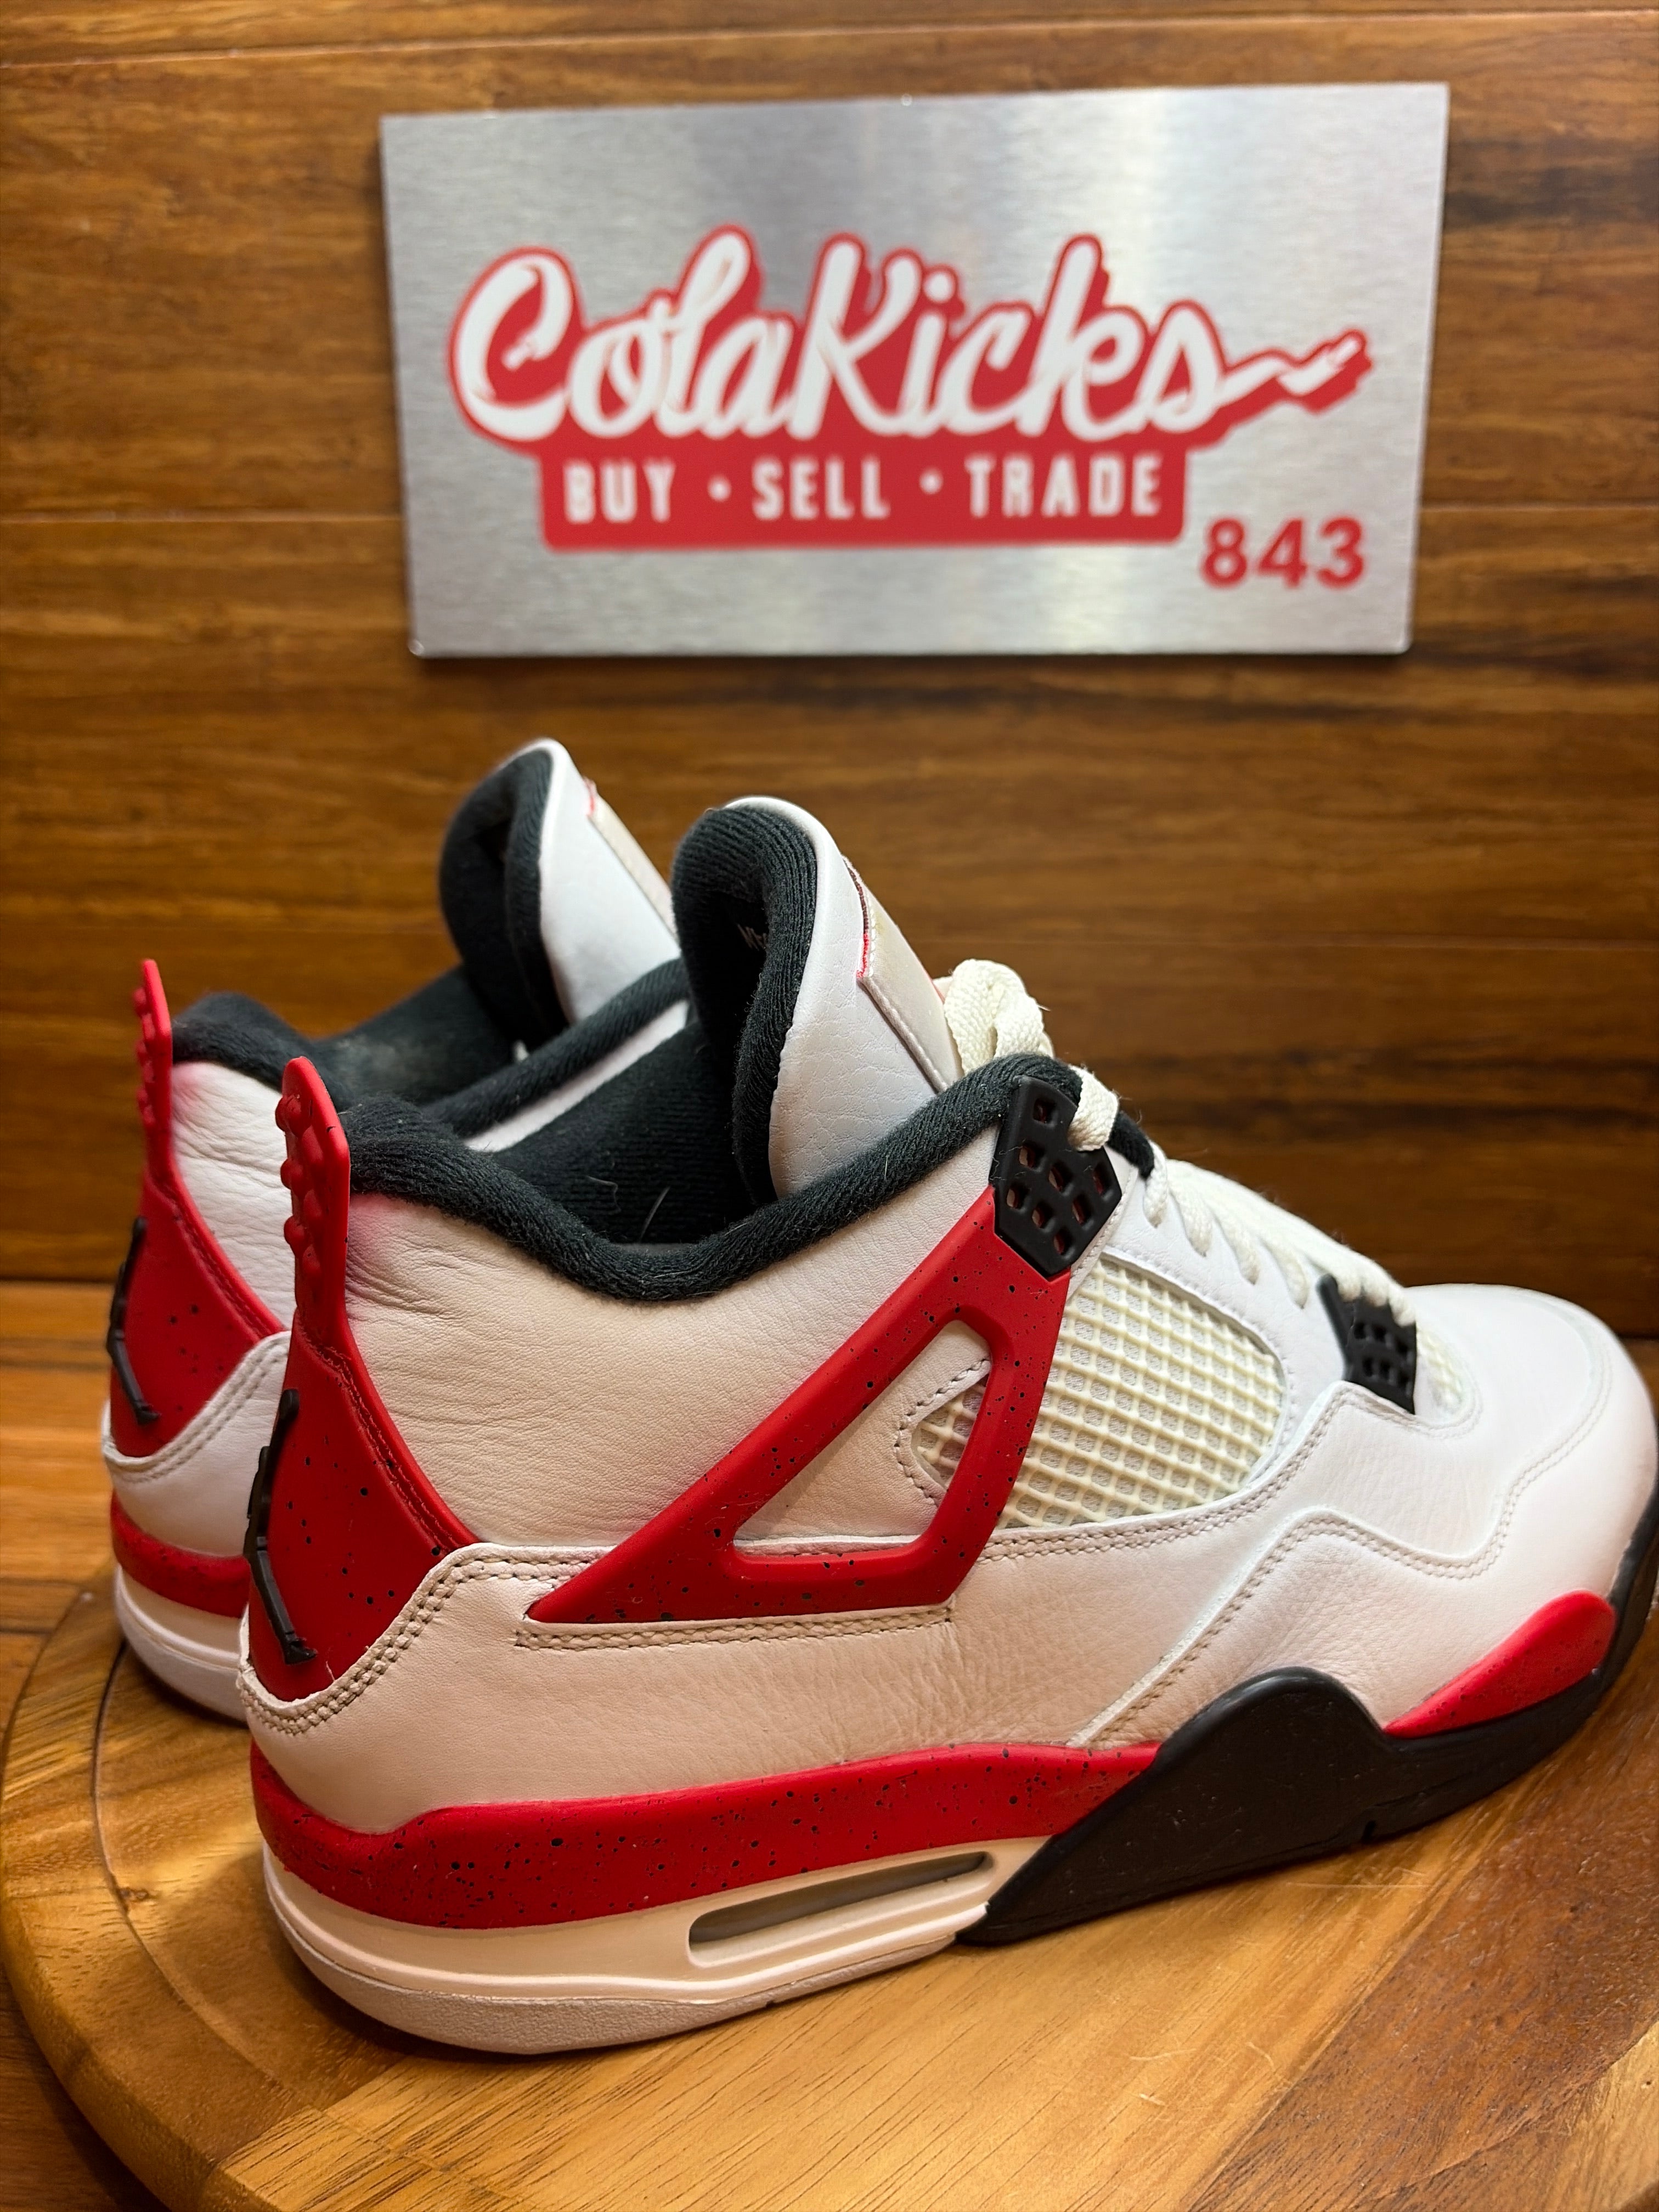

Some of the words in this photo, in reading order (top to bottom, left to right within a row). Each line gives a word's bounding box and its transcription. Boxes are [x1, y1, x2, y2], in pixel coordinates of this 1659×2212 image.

[452, 230, 1363, 442] ColaKicks
[565, 462, 674, 522] BUY
[753, 459, 887, 520] SELL
[966, 455, 1159, 517] TRADE
[1200, 515, 1366, 590] 843
